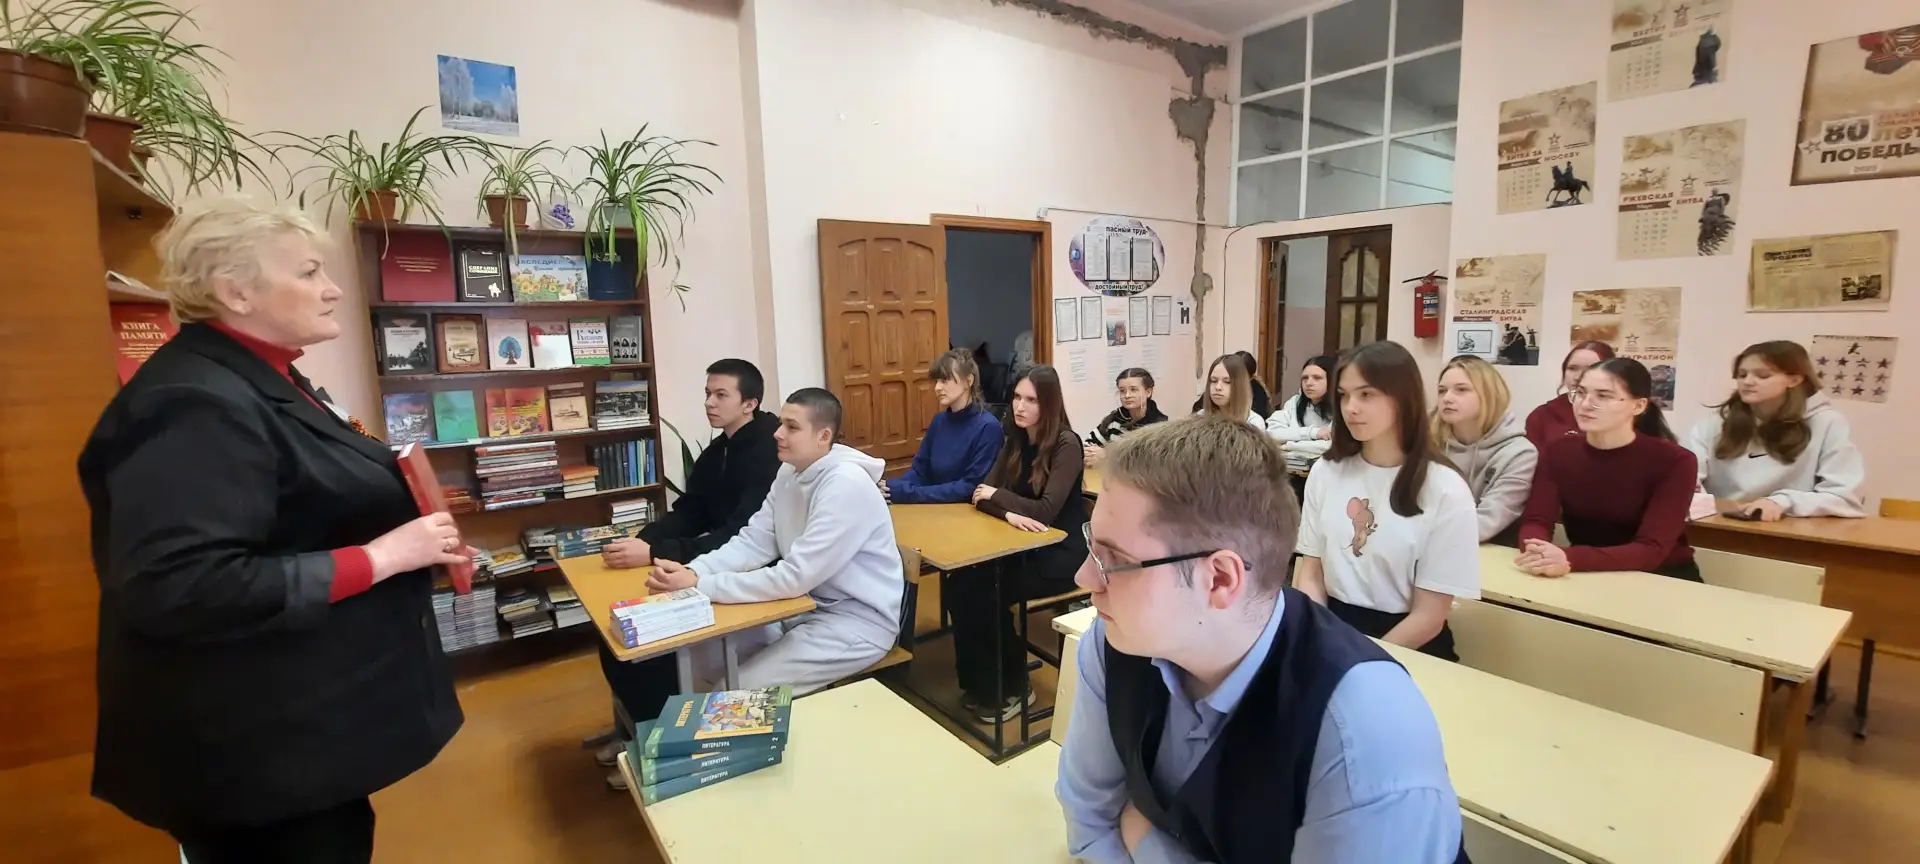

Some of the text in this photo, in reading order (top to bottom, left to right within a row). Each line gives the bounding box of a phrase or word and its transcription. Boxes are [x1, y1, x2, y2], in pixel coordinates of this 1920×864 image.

[1823, 118, 1870, 145] 80
[1622, 192, 1674, 203] РЖЕВСКАЯ
[1460, 308, 1527, 316] СТАЛИНГРАДСКАЯ
[121, 321, 160, 331] КНИГА
[120, 331, 168, 341] ПАМЯТИ
